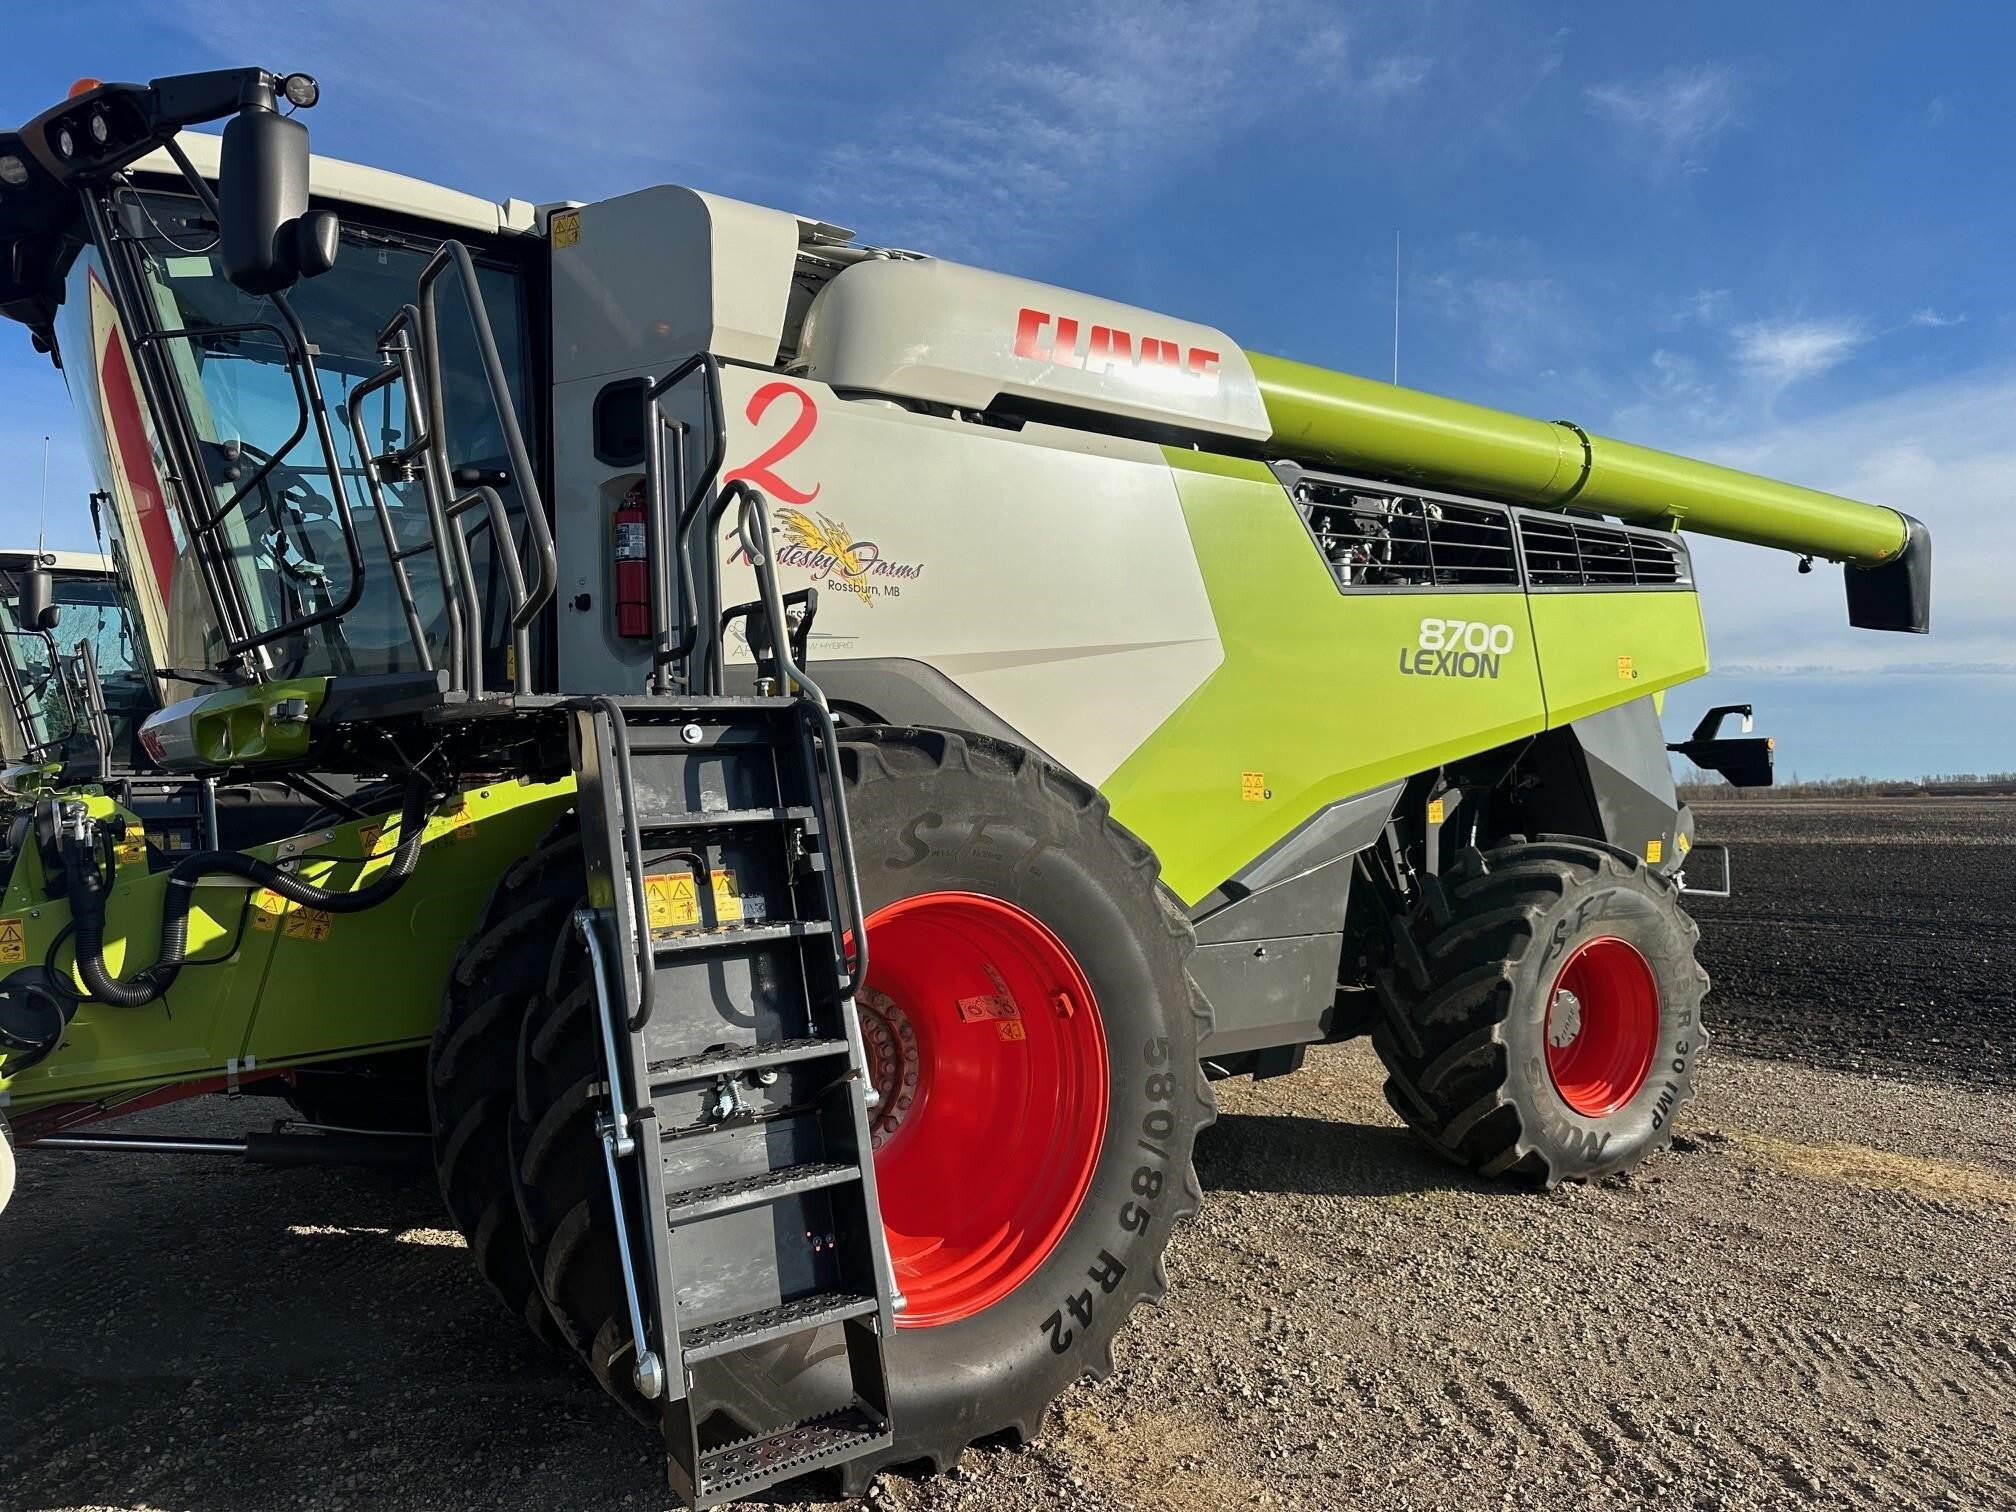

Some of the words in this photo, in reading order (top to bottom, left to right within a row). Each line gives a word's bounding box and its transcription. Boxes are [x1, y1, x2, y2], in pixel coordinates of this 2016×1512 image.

[1013, 307, 1220, 398] CLAAS
[723, 381, 821, 505] 2
[840, 540, 925, 580] Farms
[827, 579, 881, 597] Rossburn,
[884, 585, 901, 597] MB
[1418, 617, 1514, 655] 8700
[1399, 647, 1500, 679] LEXION
[1671, 1039, 1690, 1075] 30
[1652, 1080, 1679, 1132] IMP
[1119, 1036, 1177, 1238] 580/85
